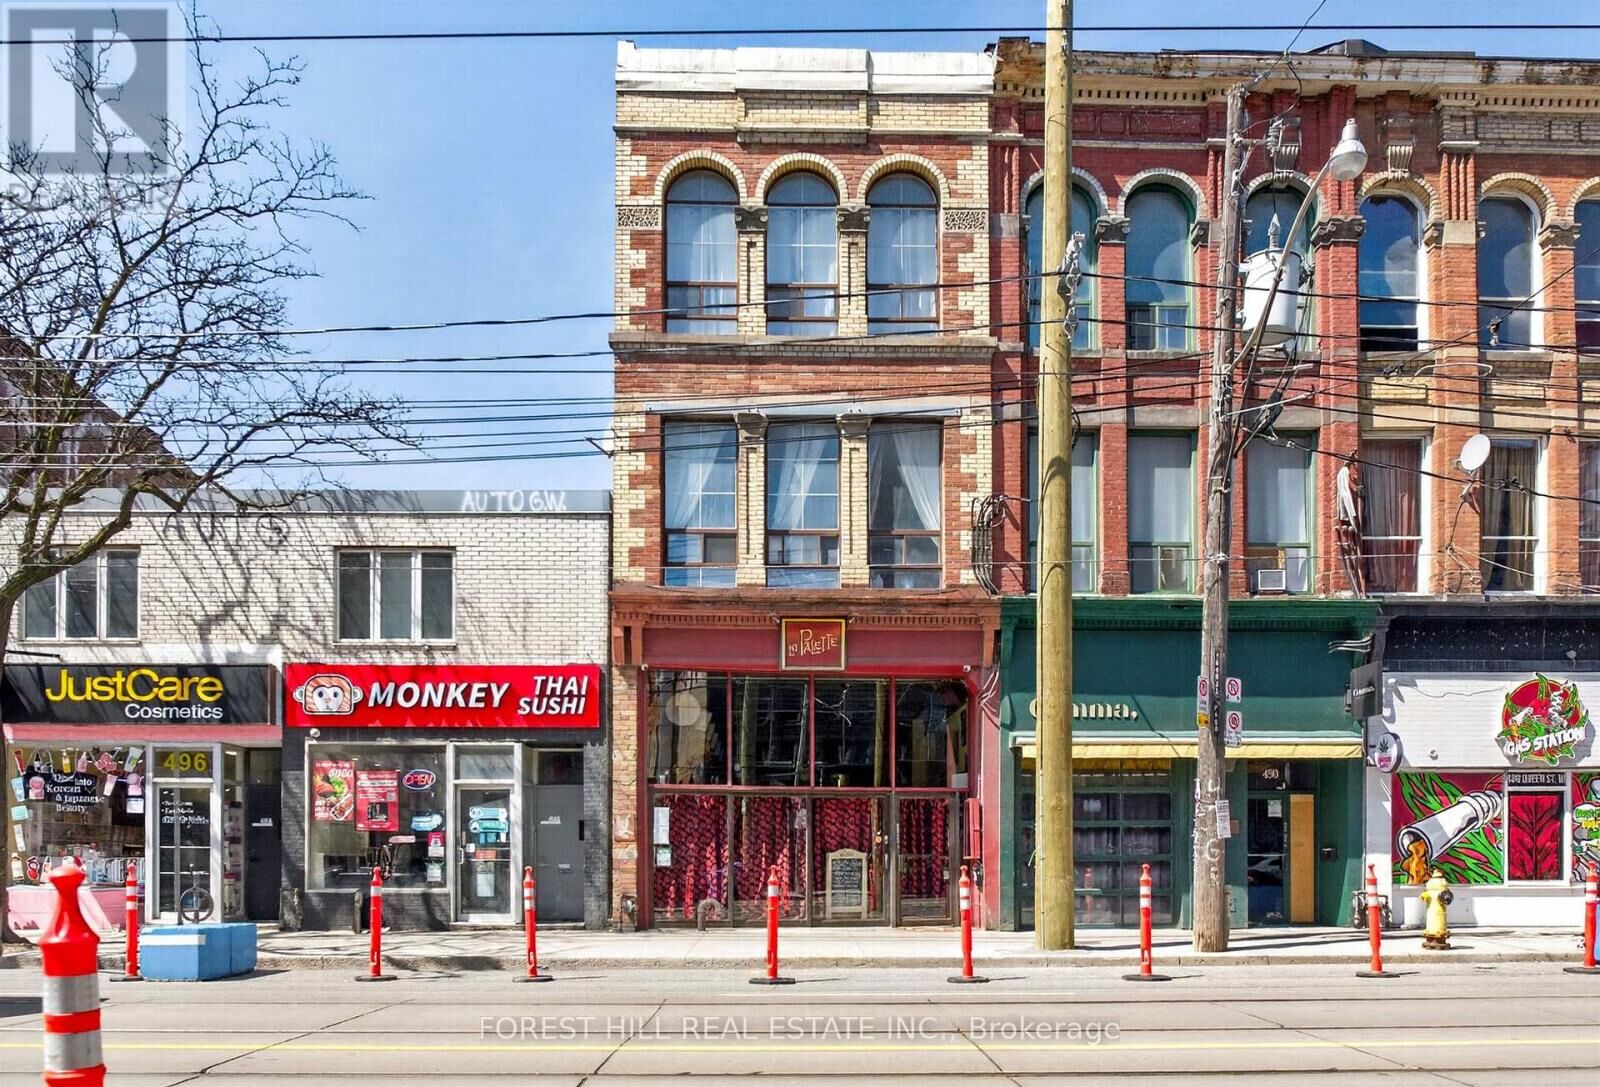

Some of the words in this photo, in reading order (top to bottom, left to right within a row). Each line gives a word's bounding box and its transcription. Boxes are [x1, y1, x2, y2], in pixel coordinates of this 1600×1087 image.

[461, 489, 524, 512] AUTO
[45, 669, 224, 702] JustCare
[368, 682, 510, 709] MONKEY
[533, 675, 588, 697] THAI
[125, 703, 223, 719] Cosmetics
[517, 696, 586, 715] SUSHI
[1533, 725, 1586, 751] STATION
[162, 752, 208, 772] 496
[46, 784, 81, 793] Korean
[405, 773, 433, 786] OPEN
